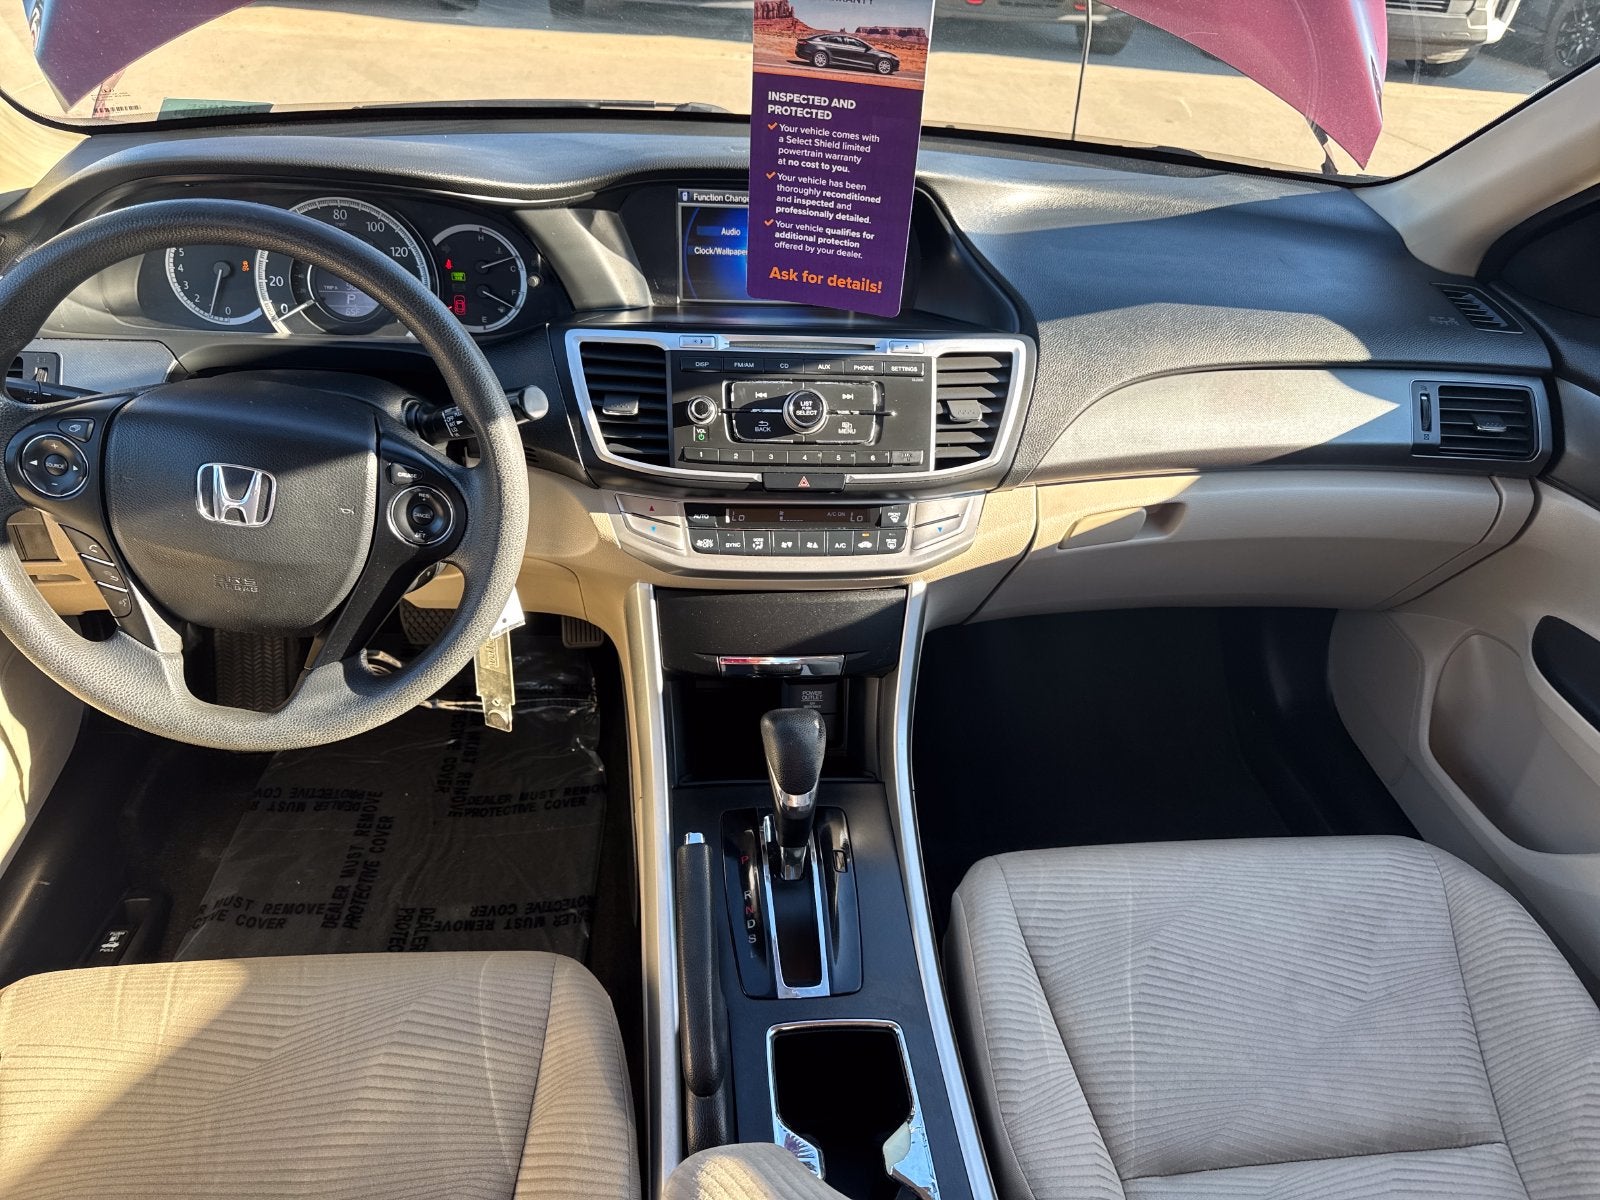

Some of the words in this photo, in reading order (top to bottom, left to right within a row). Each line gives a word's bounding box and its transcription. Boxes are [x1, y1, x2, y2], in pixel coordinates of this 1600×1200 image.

[768, 91, 829, 106] INSPECTED
[831, 98, 856, 110] AND
[767, 104, 832, 120] PROTECTED
[779, 123, 798, 134] Your
[800, 125, 830, 137] vehicle
[832, 130, 859, 140] comes
[862, 132, 880, 143] with
[786, 135, 813, 147] Select
[814, 138, 840, 150] Shield
[842, 141, 871, 153] limited
[778, 147, 823, 159] powertrain
[825, 153, 862, 165] warranty
[778, 158, 786, 166] at
[801, 160, 819, 169] cost
[821, 163, 830, 171] to
[832, 165, 850, 174] you.
[777, 172, 796, 182] Your
[798, 175, 827, 186] vehicle
[828, 178, 844, 188] has
[845, 180, 867, 191] been
[693, 193, 723, 202] Function
[776, 183, 821, 197] thoroughly
[822, 191, 881, 204] reconditioned
[776, 195, 792, 203] and
[794, 196, 834, 209] inspected
[836, 201, 852, 211] and
[333, 209, 348, 220] 80
[776, 205, 834, 220] professionally
[835, 213, 871, 224] detailed.
[366, 221, 385, 232] 100
[721, 227, 741, 236] Audio
[775, 220, 794, 230] Your
[795, 222, 824, 233] vehicle
[825, 226, 861, 239] qualifies
[862, 231, 875, 240] for
[774, 231, 816, 243] additional
[818, 235, 860, 248] protection
[179, 248, 185, 256] 5
[390, 247, 409, 257] 120
[774, 241, 803, 251] offered
[805, 243, 815, 253] by
[816, 247, 834, 256] your
[836, 249, 863, 259] dealer.
[177, 264, 184, 272] 4
[183, 281, 189, 290] 3
[269, 276, 284, 287] 20
[769, 266, 798, 282] Ask
[802, 270, 823, 285] for
[827, 274, 882, 293] details!
[194, 294, 200, 303] 2
[347, 294, 356, 304] P
[225, 307, 232, 315] 0
[280, 303, 289, 314] 0
[45, 462, 65, 470] SOURCE
[413, 511, 431, 519] CANCEL
[520, 788, 556, 801] MUST
[463, 804, 536, 818] PROTECTIVE
[544, 796, 588, 810] COVER
[321, 884, 351, 929] DEALER
[340, 845, 366, 879] MUST
[353, 791, 384, 837] REMOVE
[741, 855, 749, 864] P
[342, 860, 381, 930] PROTECTIVE
[369, 815, 395, 854] COVER
[744, 890, 752, 899] R
[261, 903, 325, 915] REMOVE
[470, 903, 517, 917] COVER
[745, 906, 754, 914] N
[235, 914, 288, 930] COVER
[433, 919, 495, 933] REMOVE
[503, 917, 545, 930] MUST
[747, 919, 755, 929] D
[749, 934, 756, 943] S
